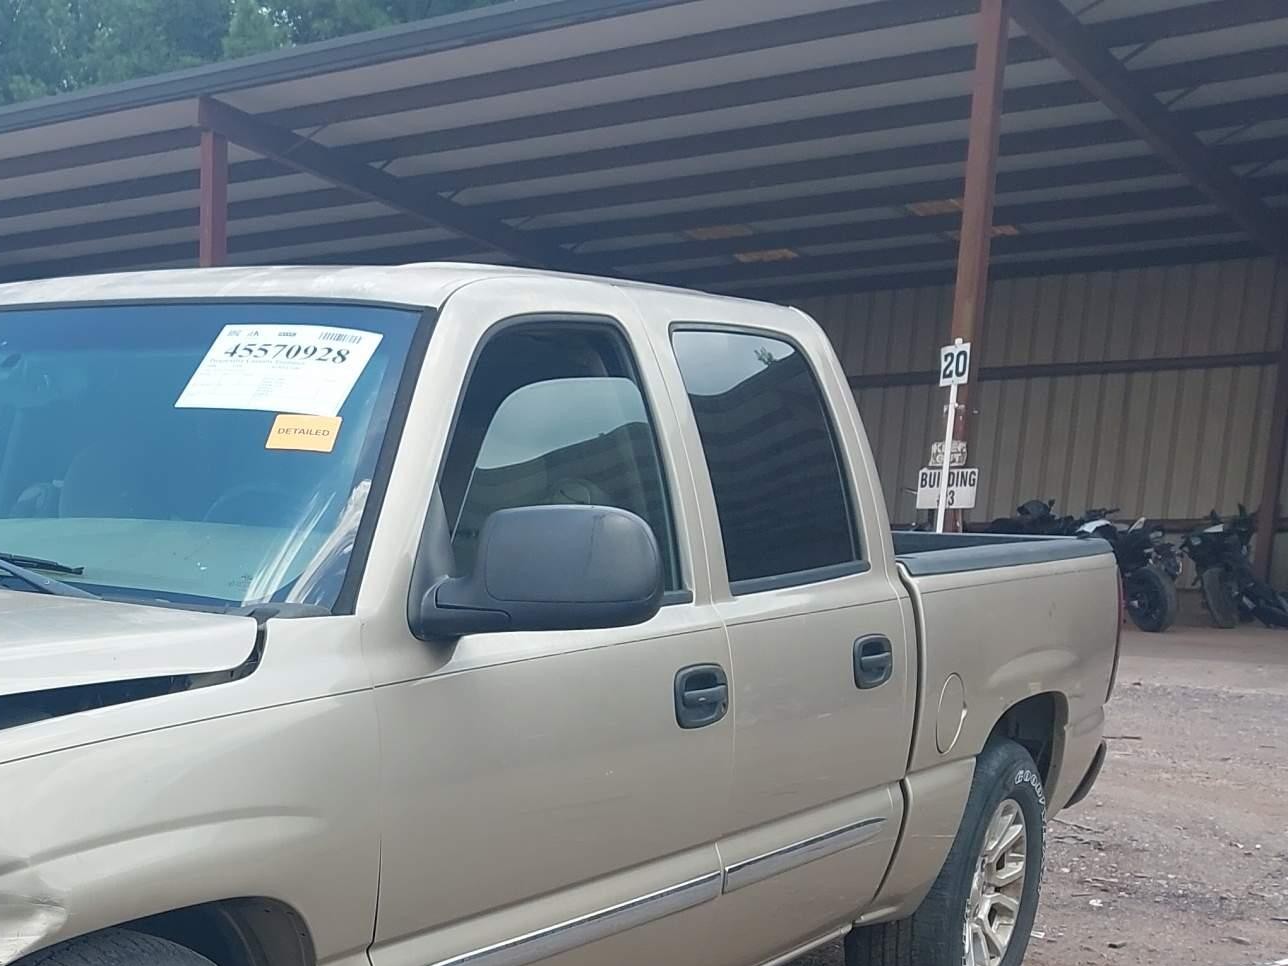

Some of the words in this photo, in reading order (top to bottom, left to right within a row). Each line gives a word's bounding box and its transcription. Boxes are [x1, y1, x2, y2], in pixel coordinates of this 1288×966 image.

[224, 343, 351, 364] 45570928
[942, 350, 968, 380] 20
[278, 427, 331, 437] DETAILED
[920, 470, 977, 489] BUIDING
